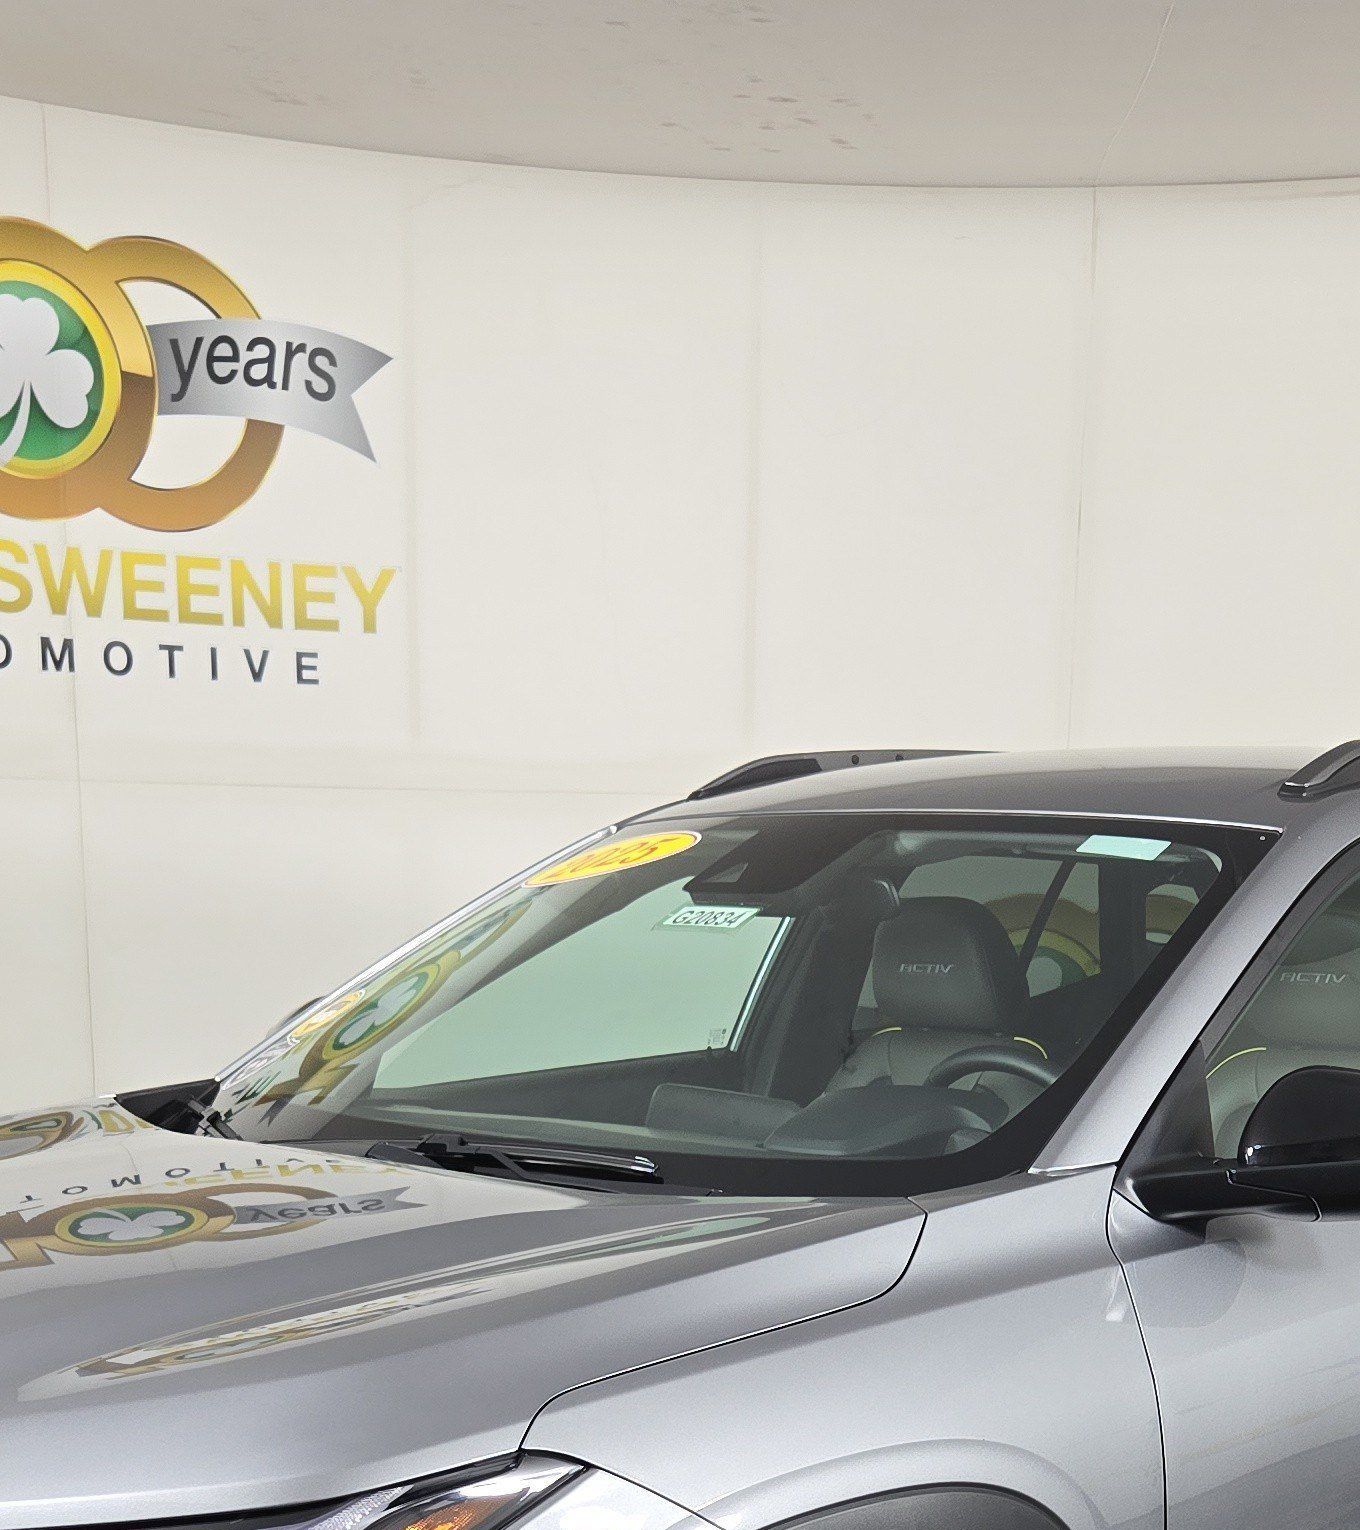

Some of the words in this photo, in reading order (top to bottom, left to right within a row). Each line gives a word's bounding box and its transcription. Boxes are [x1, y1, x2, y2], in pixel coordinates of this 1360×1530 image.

[169, 334, 339, 402] years
[540, 836, 680, 882] 2025
[672, 910, 748, 927] G20834
[900, 963, 954, 974] ACTIV
[1280, 972, 1347, 984] ACTIV
